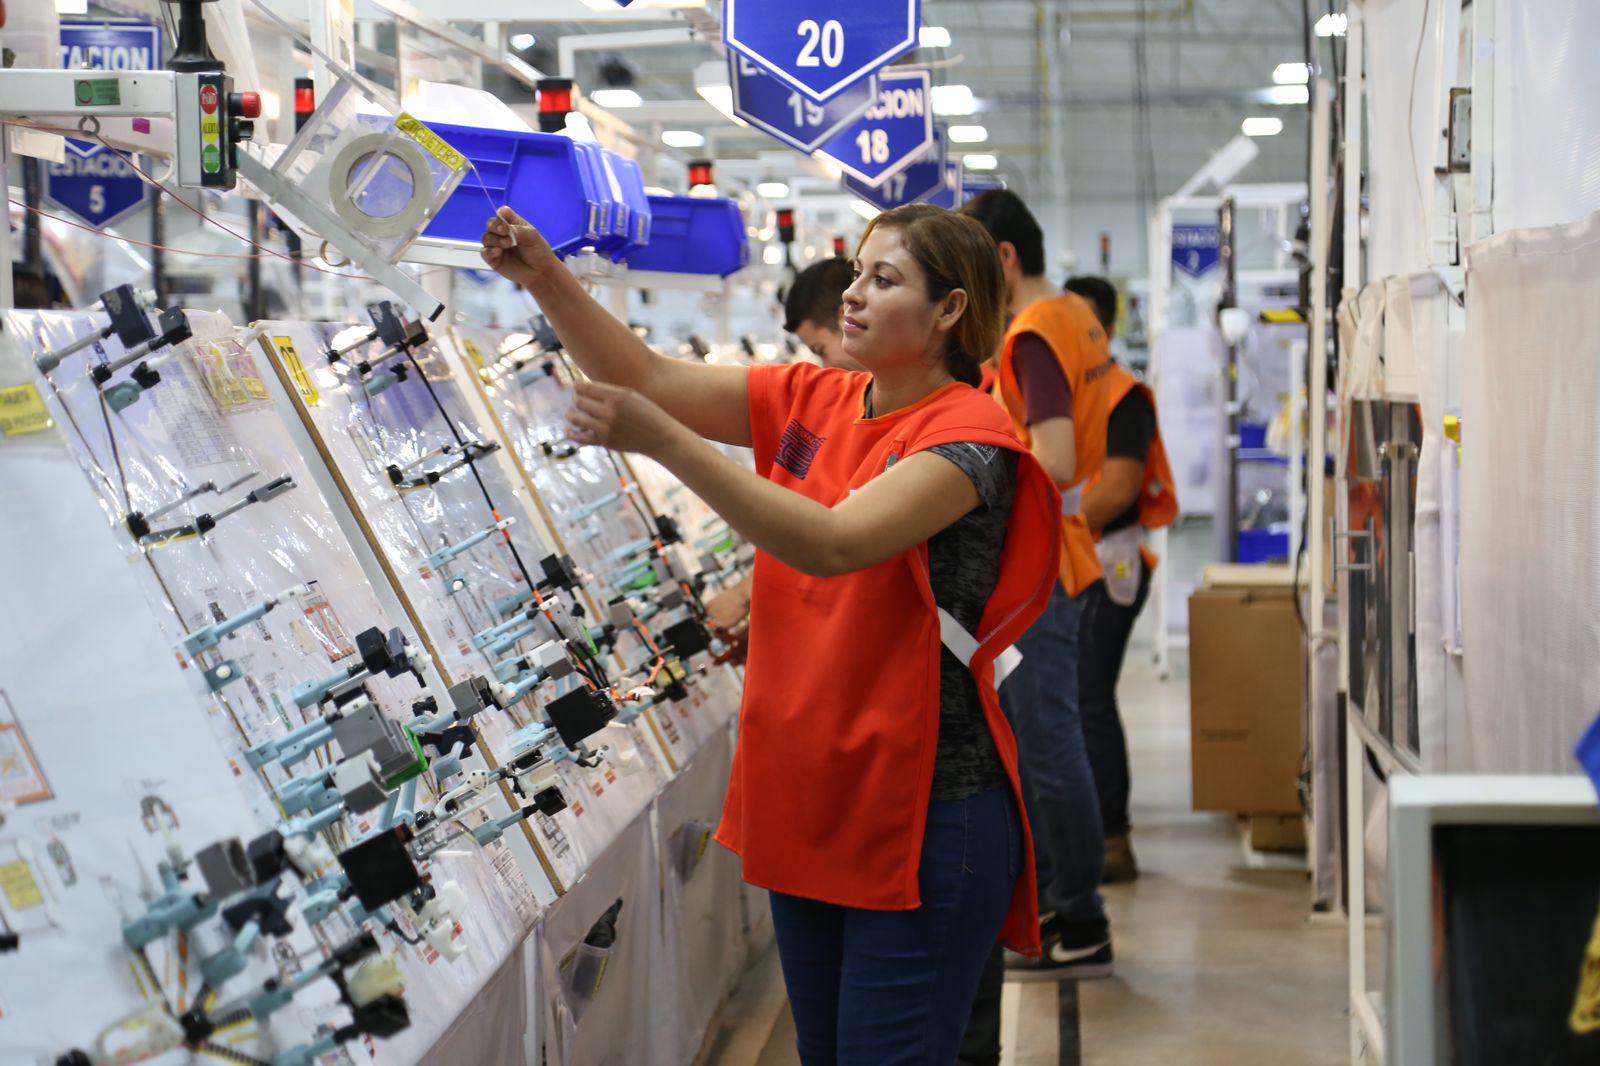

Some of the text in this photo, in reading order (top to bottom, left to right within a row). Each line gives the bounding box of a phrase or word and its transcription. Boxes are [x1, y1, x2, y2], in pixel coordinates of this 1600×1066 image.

[796, 20, 844, 67] 20
[788, 92, 824, 127] 19
[864, 88, 924, 120] CION
[856, 129, 888, 164] 18
[90, 185, 105, 213] 5
